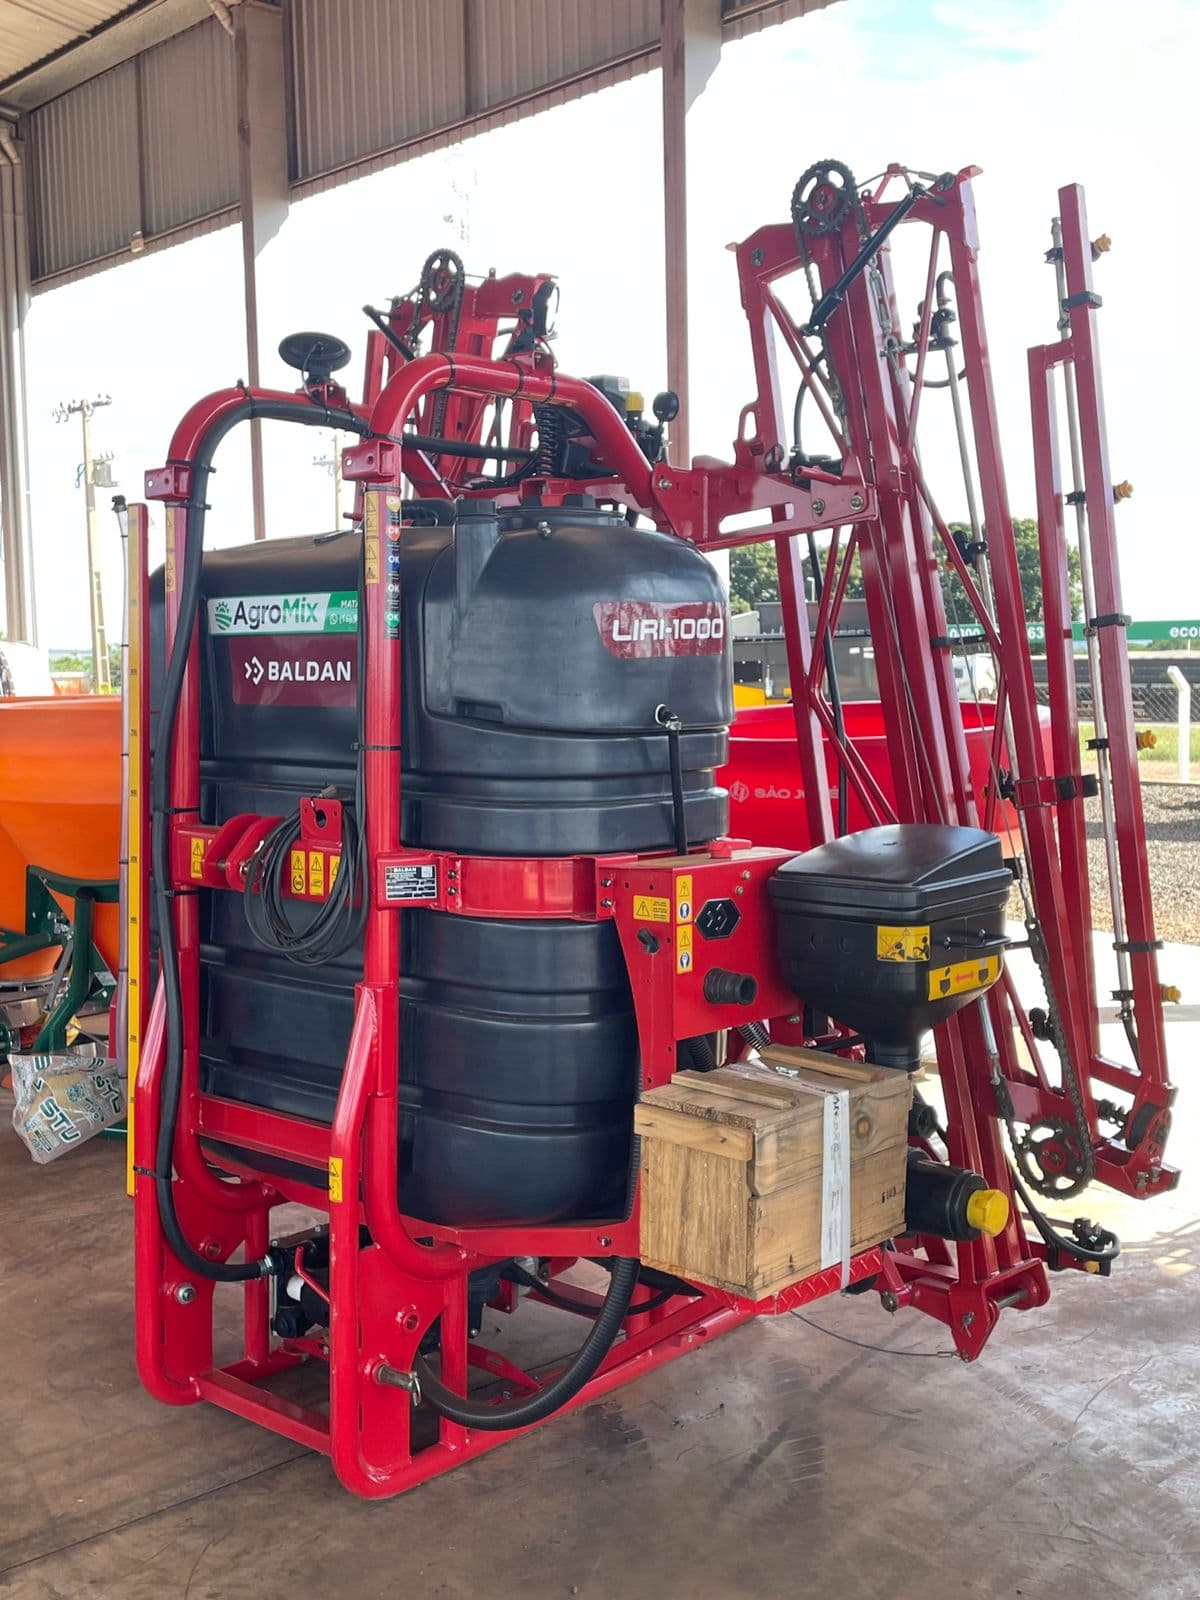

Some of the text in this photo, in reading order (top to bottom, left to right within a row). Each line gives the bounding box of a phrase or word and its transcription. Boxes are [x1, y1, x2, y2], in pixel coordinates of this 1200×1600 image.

[388, 555, 399, 563] OK
[387, 584, 399, 592] OK
[233, 597, 319, 630] AgroMix
[387, 613, 398, 621] OK
[612, 618, 723, 641] LIRI-1000
[268, 661, 351, 681] BALDAN
[40, 1097, 81, 1143] STU
